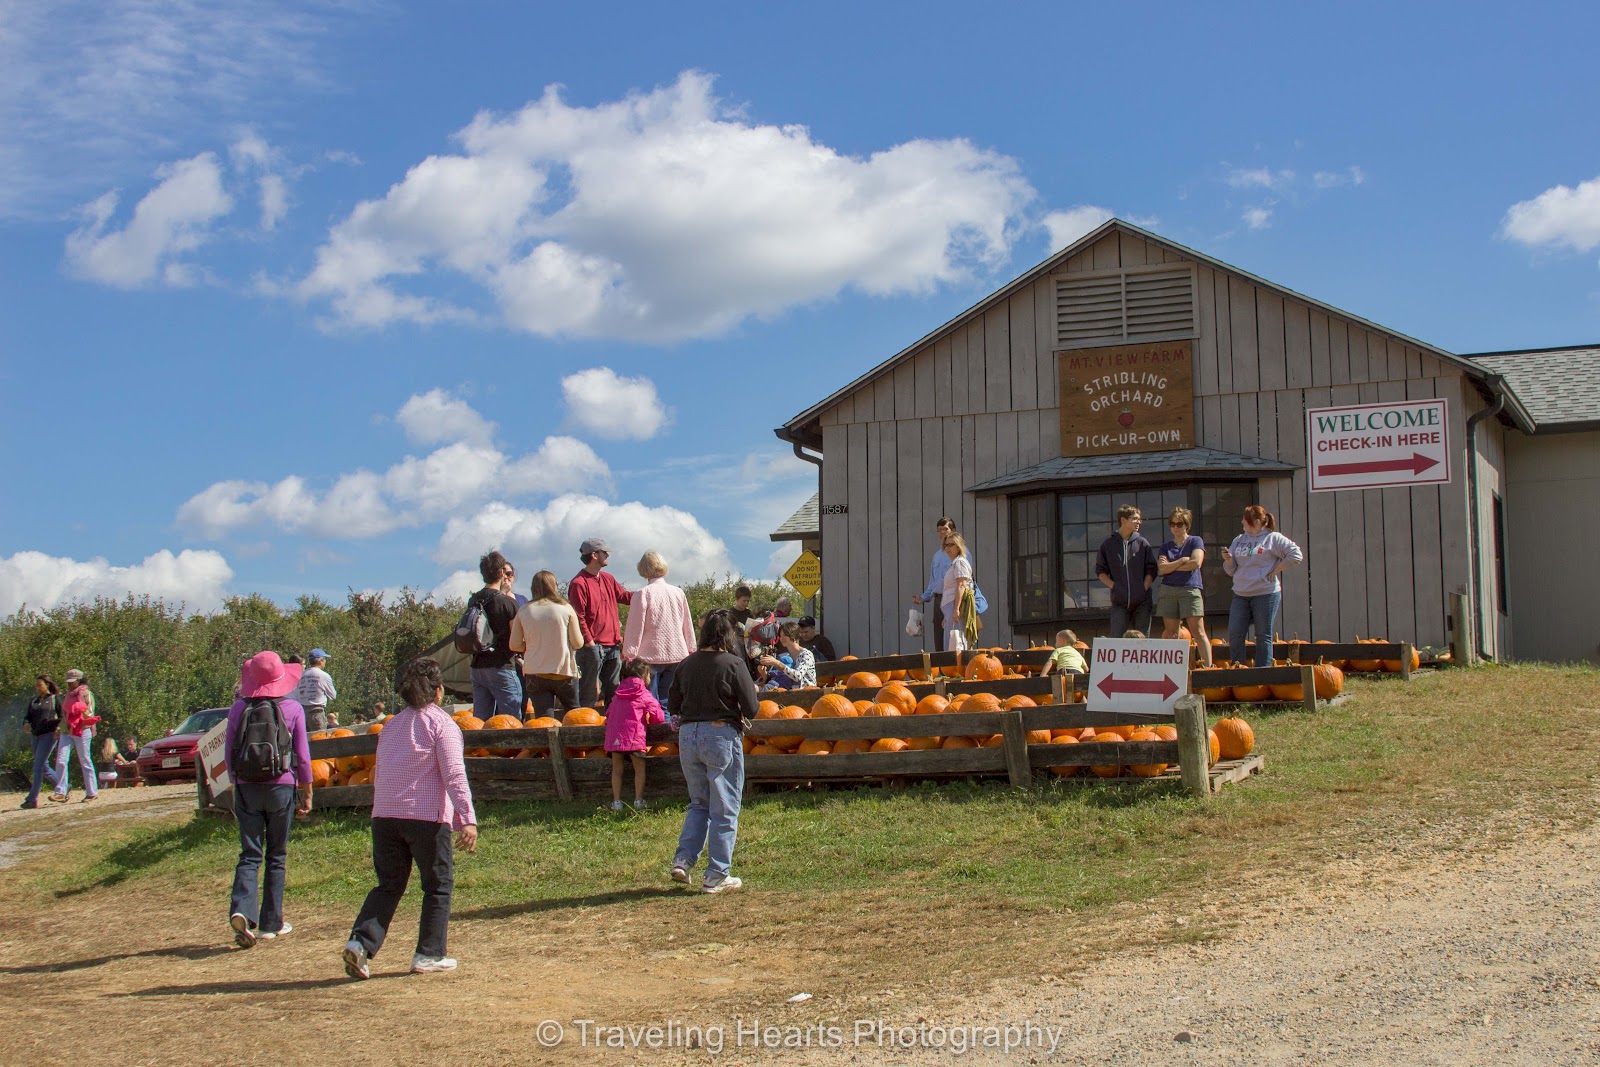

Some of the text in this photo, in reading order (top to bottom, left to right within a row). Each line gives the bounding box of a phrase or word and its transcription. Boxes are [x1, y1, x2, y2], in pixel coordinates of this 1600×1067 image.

[1143, 349, 1184, 363] FARM
[1084, 371, 1167, 395] STRIBLING
[1090, 389, 1163, 412] ORCHARD
[1317, 407, 1440, 434] WELCOME
[1076, 429, 1181, 449] PICK-UR-OWN
[1317, 431, 1440, 452] CHECK-IN HERE
[822, 504, 848, 515] 11587
[1096, 648, 1184, 664] NO PARKING
[201, 745, 209, 760] NO
